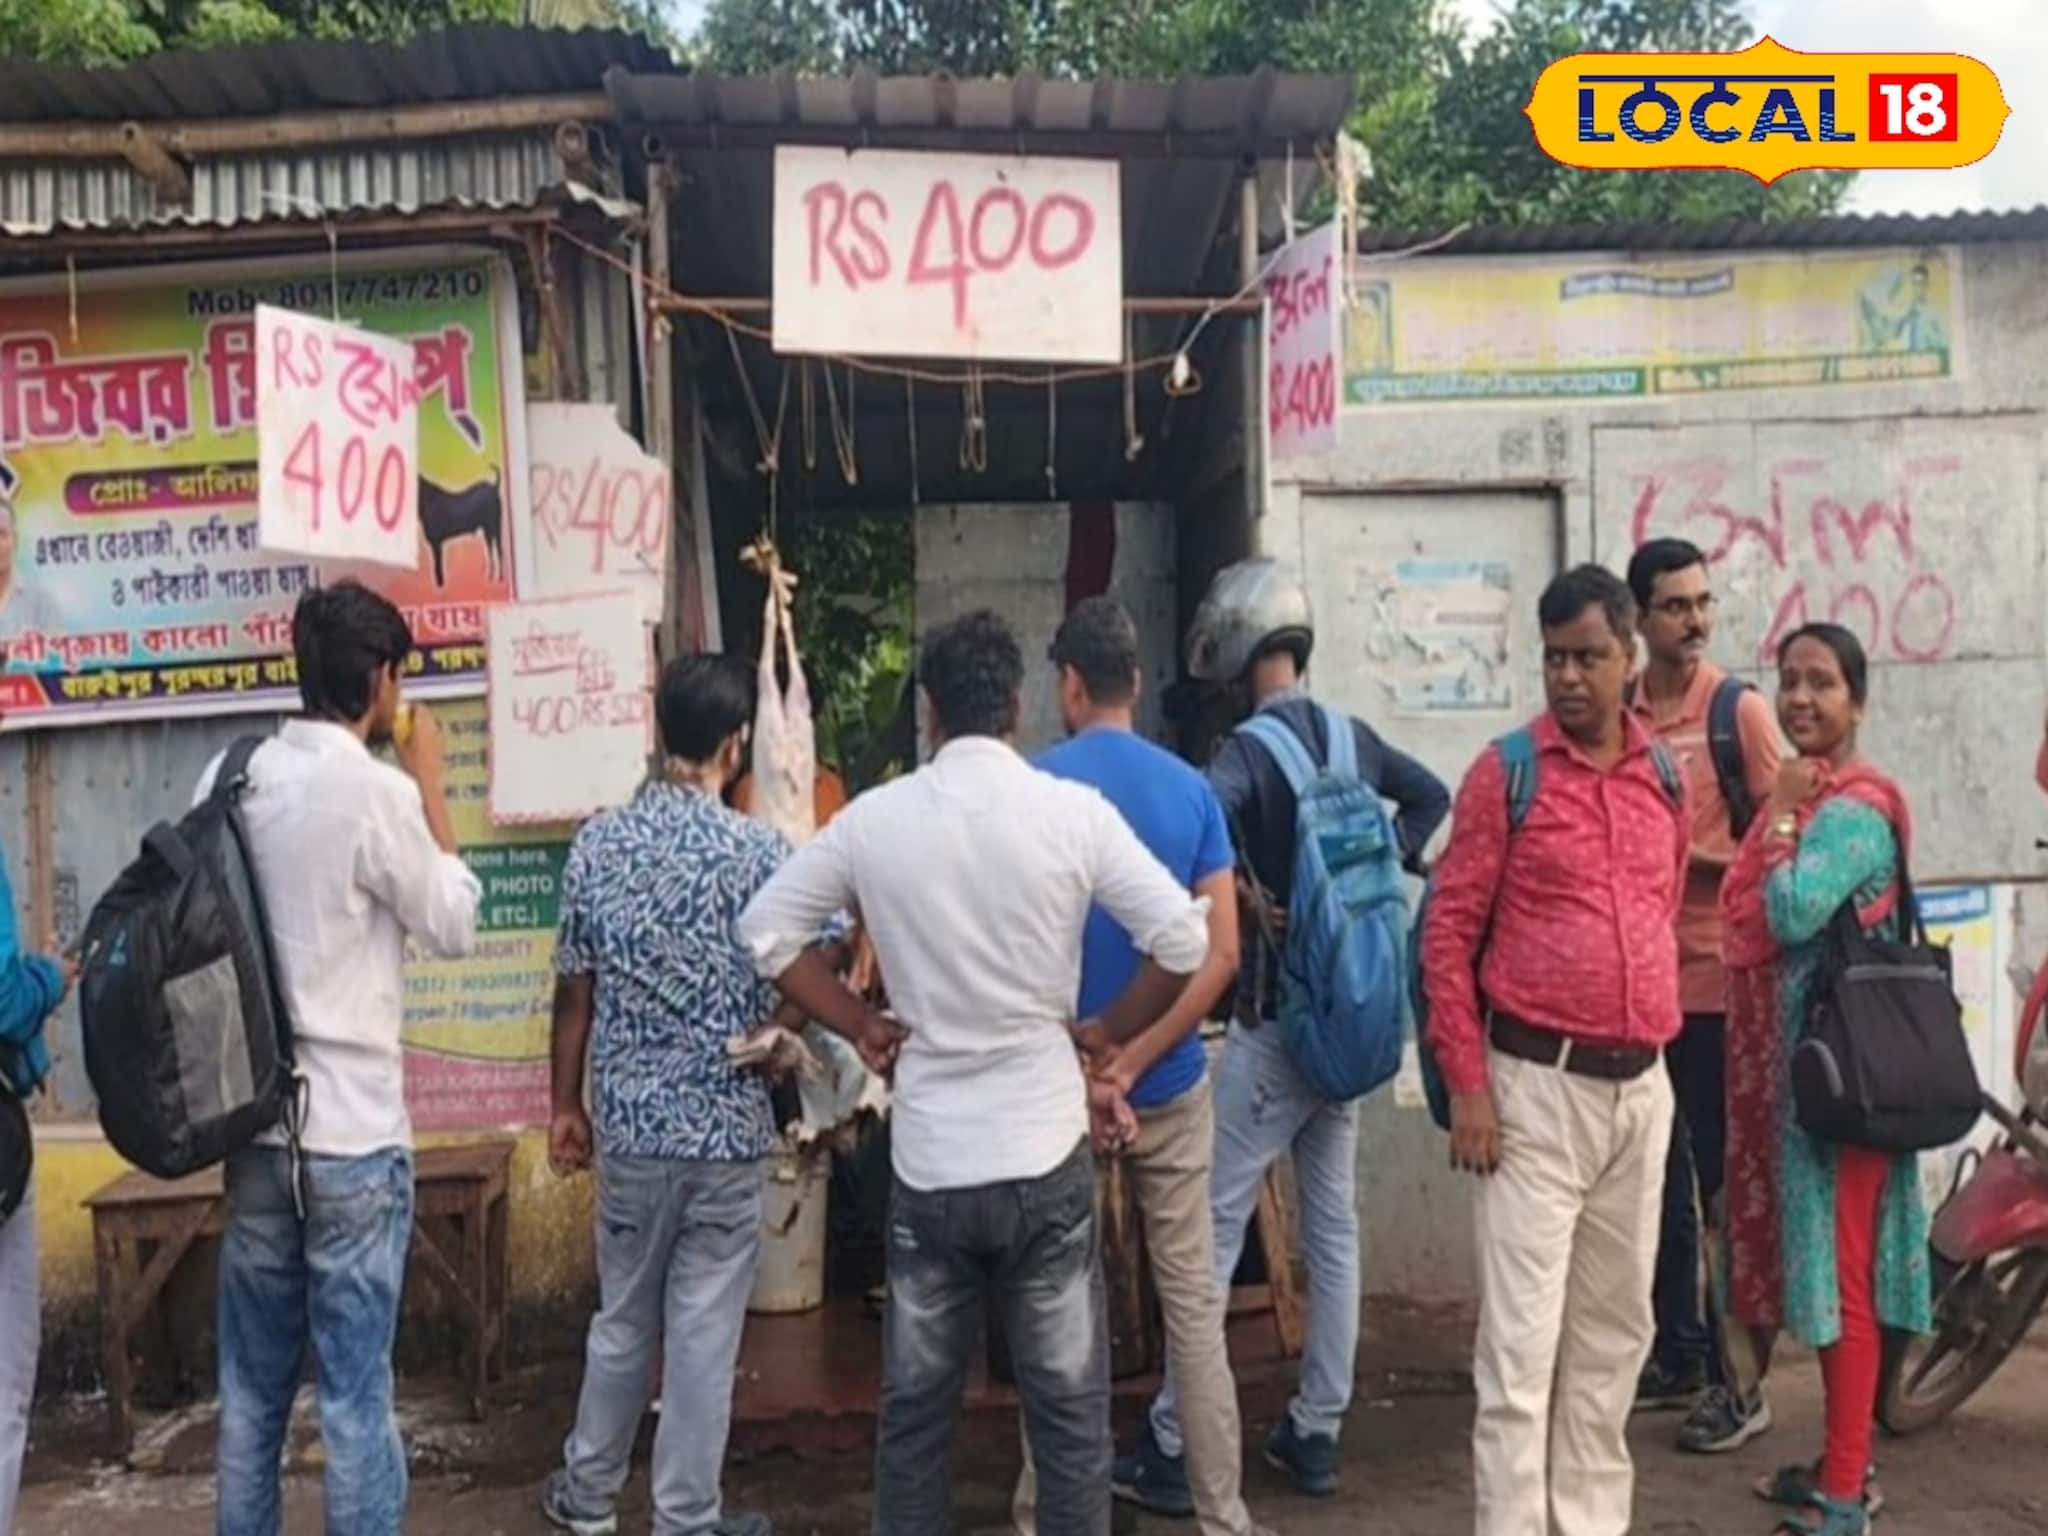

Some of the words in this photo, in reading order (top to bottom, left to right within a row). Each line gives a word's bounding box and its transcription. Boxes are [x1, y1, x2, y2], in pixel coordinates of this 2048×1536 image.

[803, 181, 891, 291] RS
[907, 179, 1096, 331] 400
[274, 327, 323, 389] RS
[283, 420, 407, 532] 400
[490, 875, 554, 898] PHOTO
